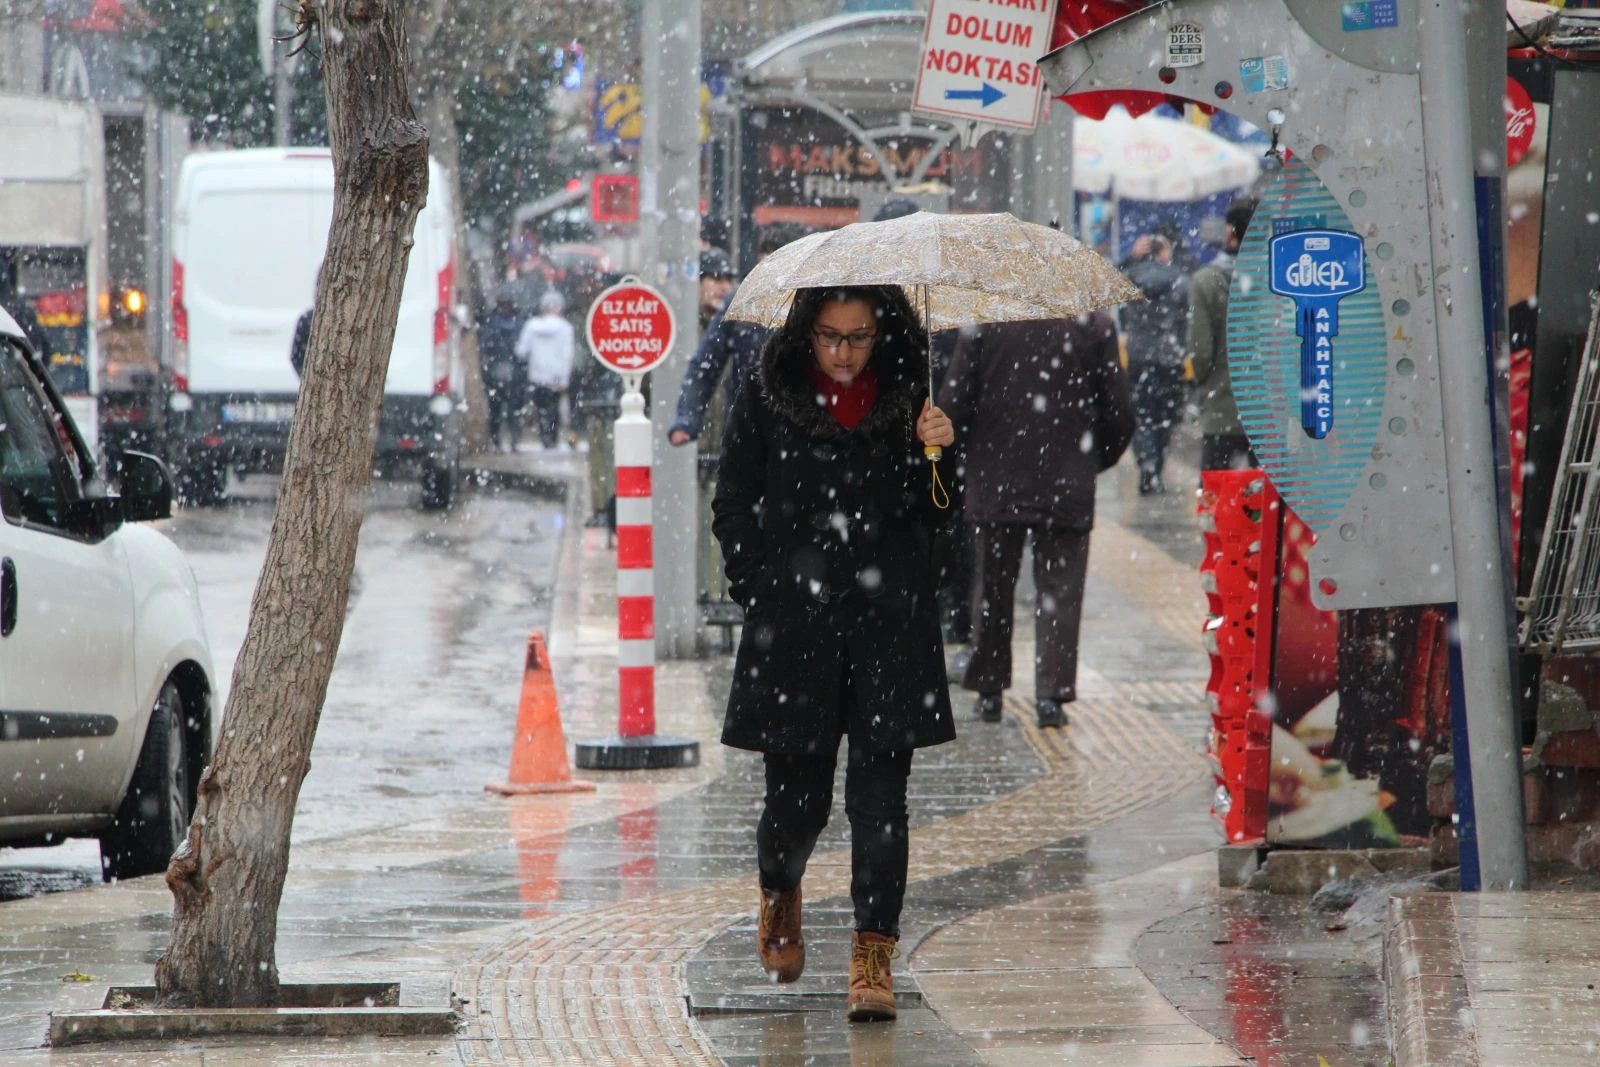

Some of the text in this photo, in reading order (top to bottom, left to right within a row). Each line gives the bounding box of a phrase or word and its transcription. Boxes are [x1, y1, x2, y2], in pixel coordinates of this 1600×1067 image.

[946, 12, 1033, 48] DOLUM
[1171, 34, 1202, 44] DERS
[926, 48, 1040, 87] NOKTASI
[602, 300, 659, 314] ELZ KART
[609, 318, 652, 336] SATIŞ
[598, 338, 662, 353] NOKTASI
[1315, 307, 1331, 433] ANAHTARCI
